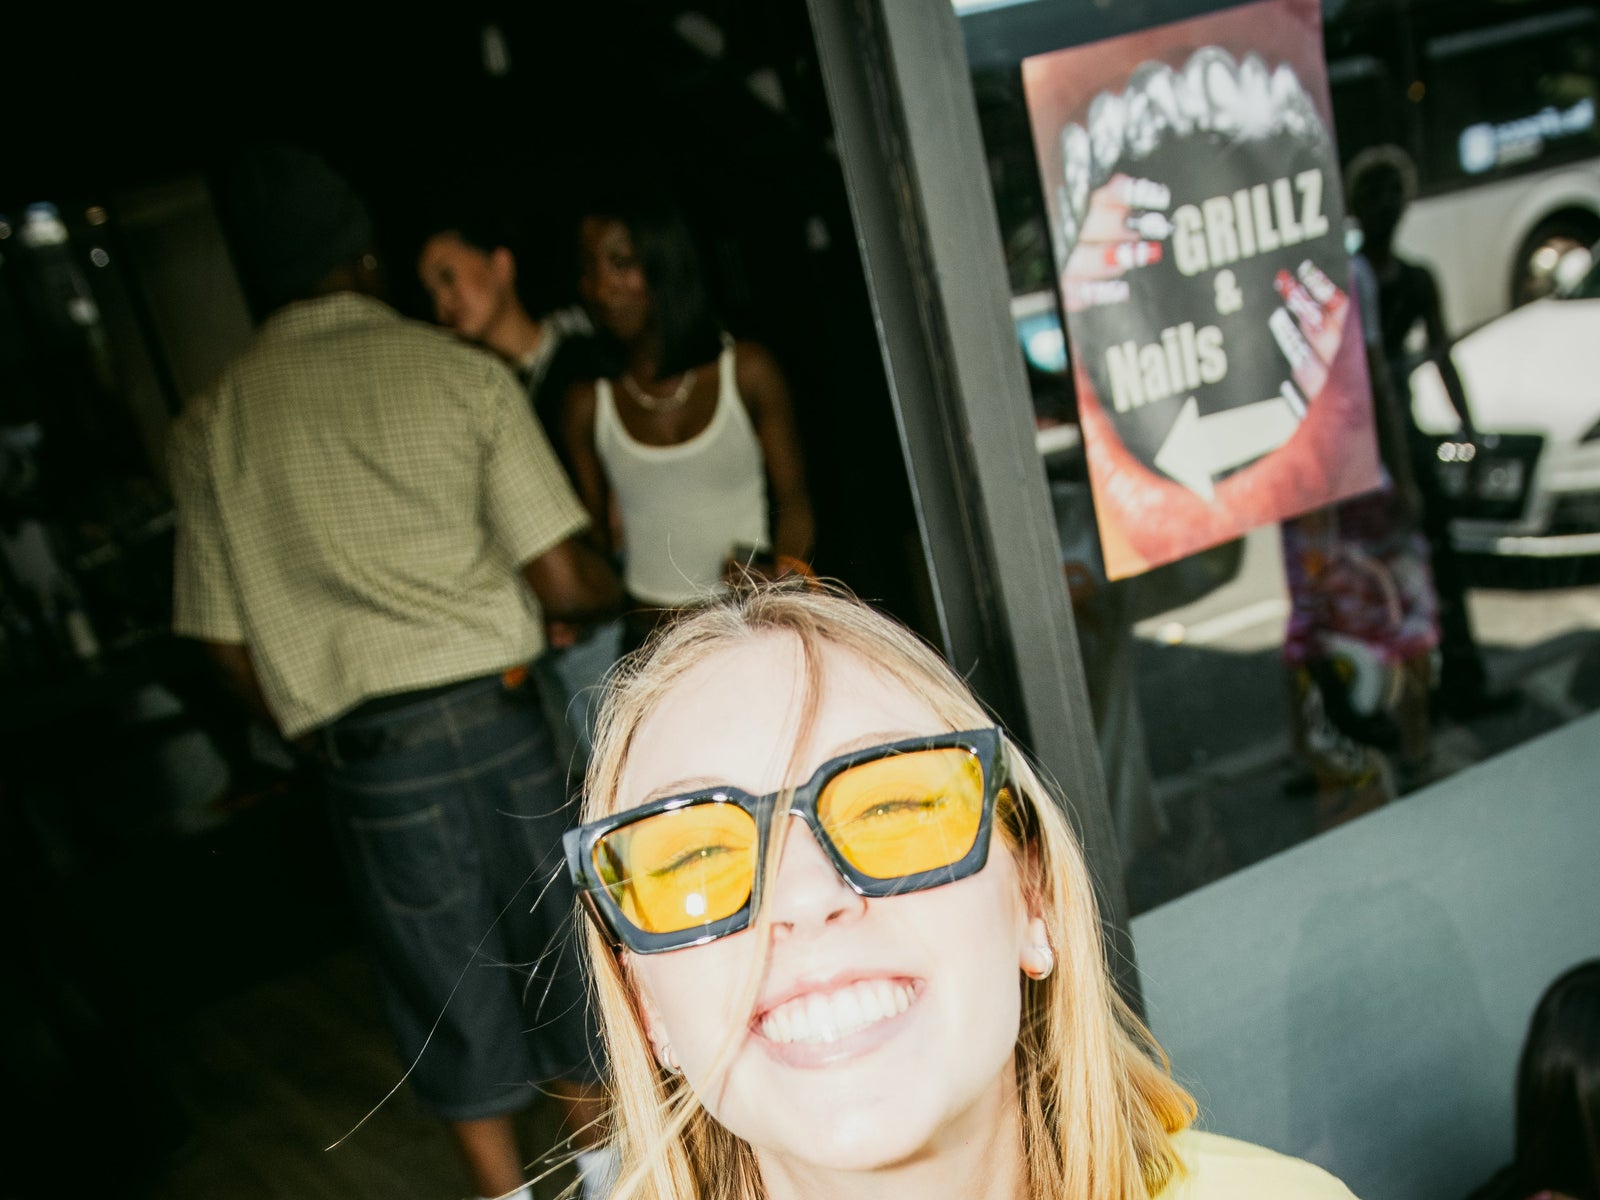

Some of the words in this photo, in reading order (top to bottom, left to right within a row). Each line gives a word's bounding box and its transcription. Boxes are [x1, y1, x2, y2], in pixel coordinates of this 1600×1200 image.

[1172, 168, 1329, 277] GRILLZ
[1214, 268, 1243, 315] &
[1105, 321, 1228, 413] Nails
